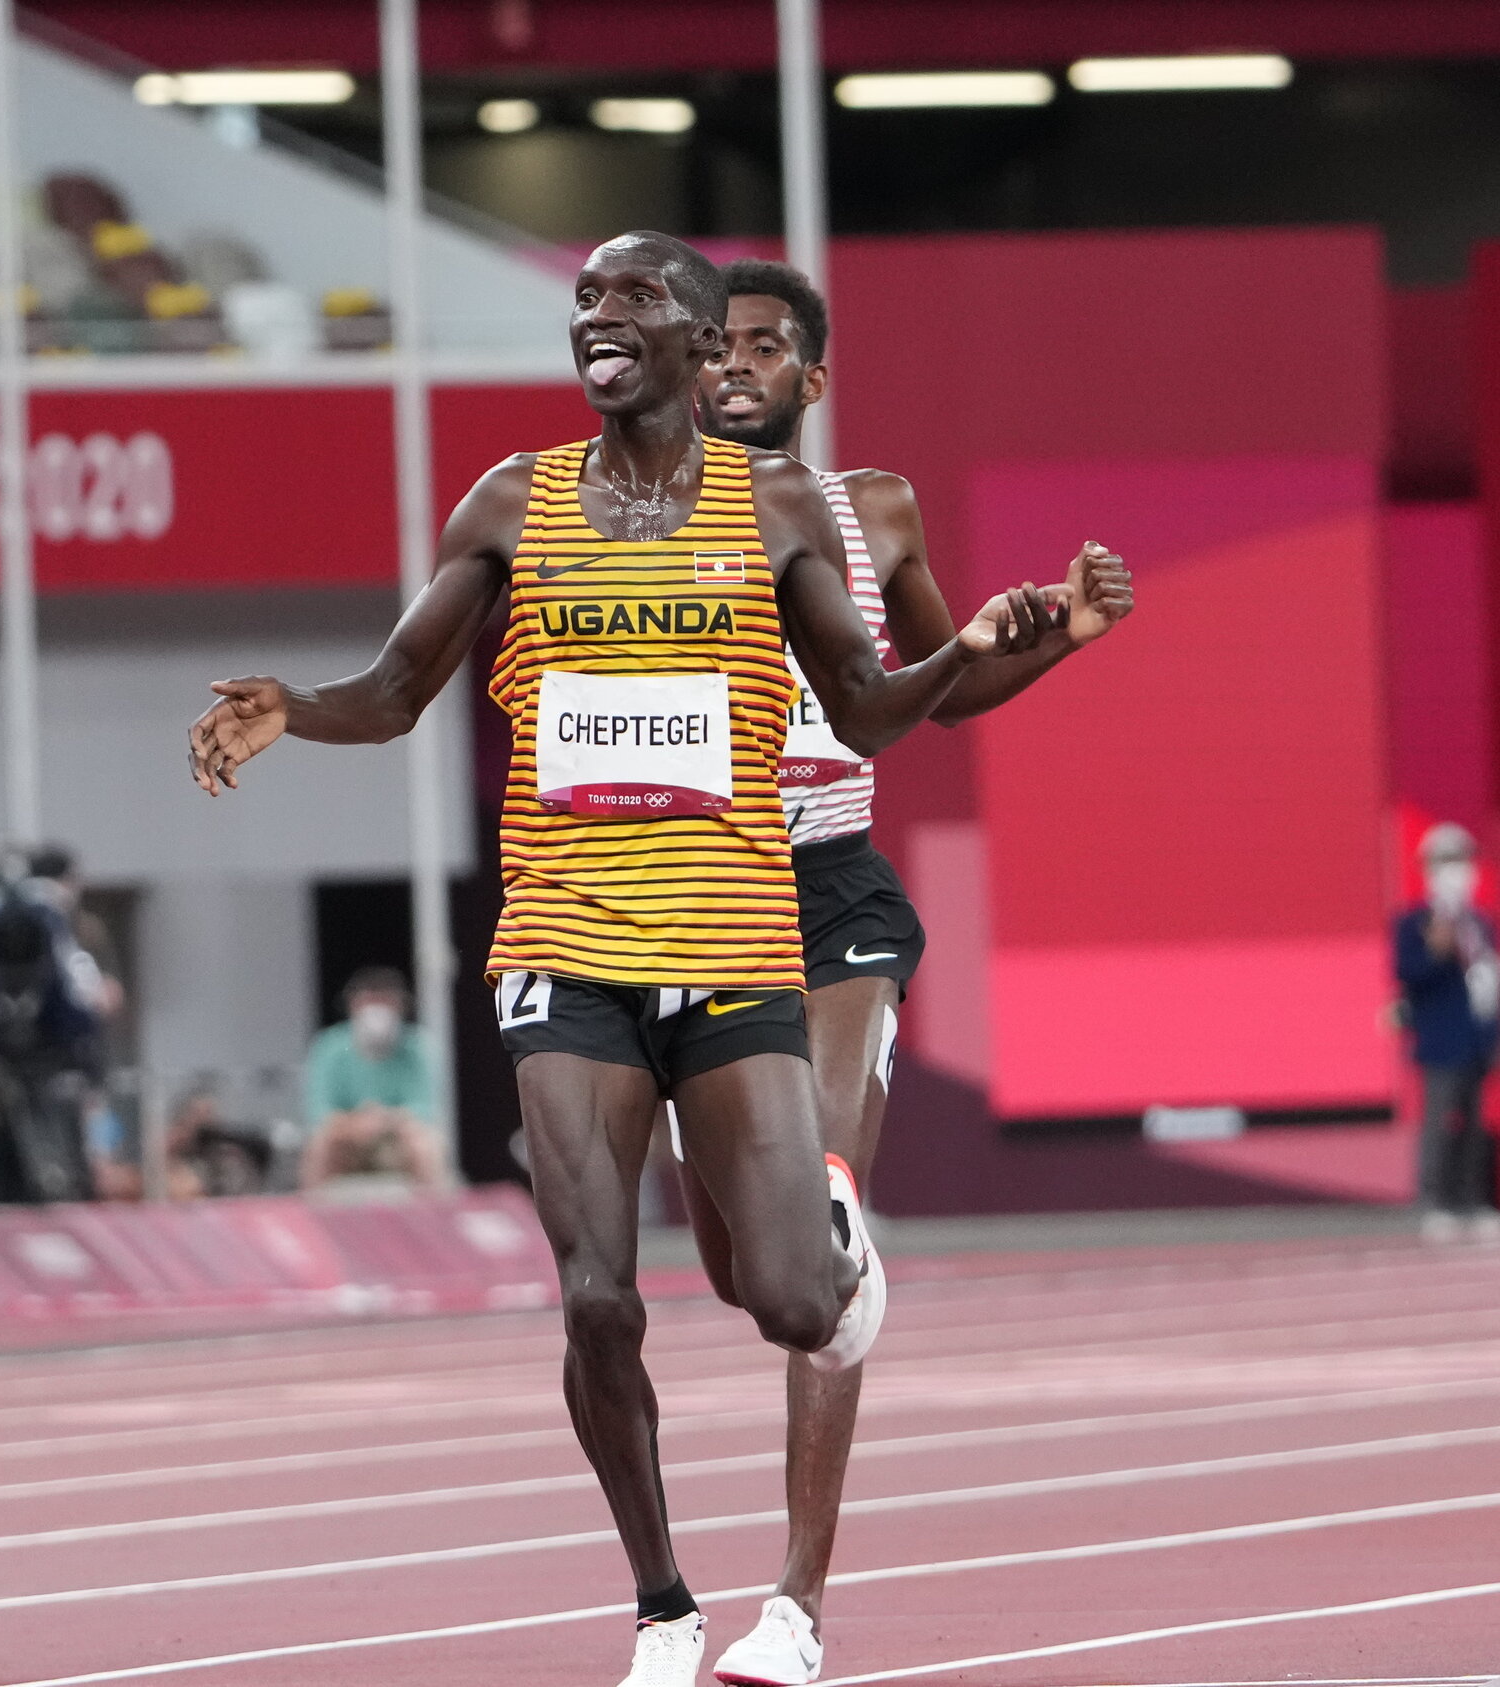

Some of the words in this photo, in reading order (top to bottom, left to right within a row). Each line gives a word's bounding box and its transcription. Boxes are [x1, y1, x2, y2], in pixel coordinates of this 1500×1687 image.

[539, 603, 735, 637] UGANDA
[558, 712, 708, 746] CHEPTEGEI
[588, 794, 617, 804] TOKYO
[618, 795, 641, 805] 2020
